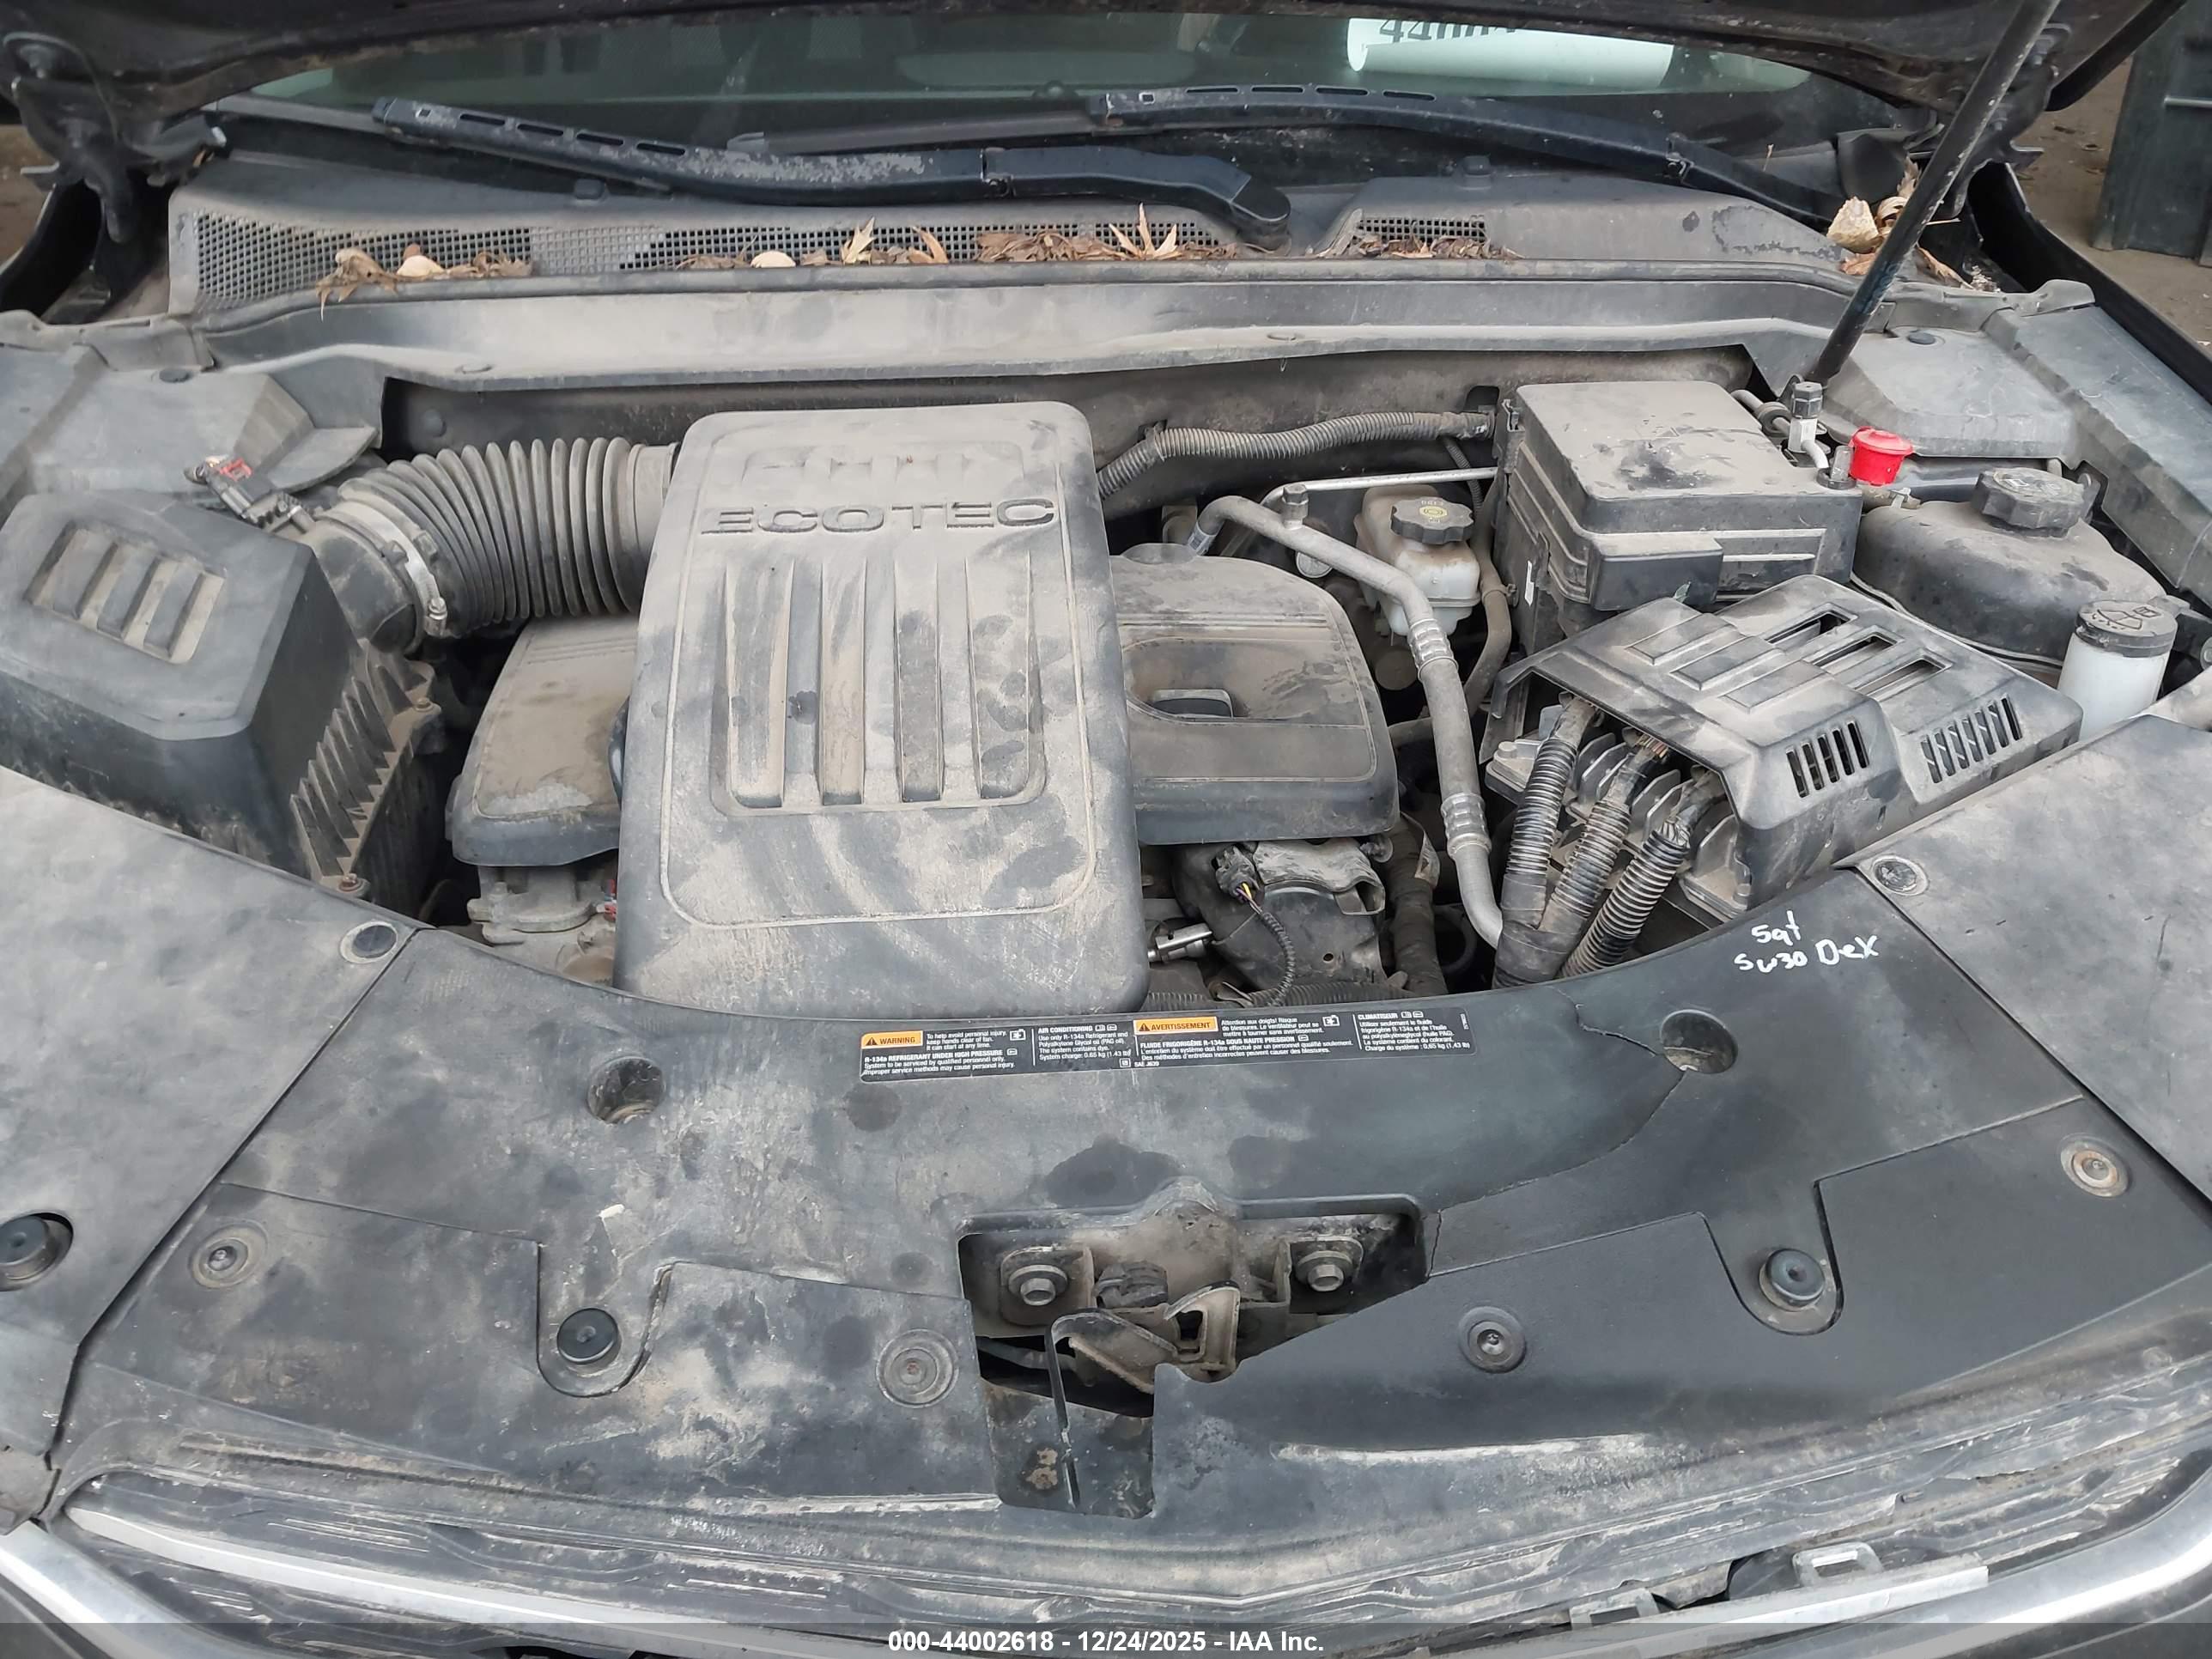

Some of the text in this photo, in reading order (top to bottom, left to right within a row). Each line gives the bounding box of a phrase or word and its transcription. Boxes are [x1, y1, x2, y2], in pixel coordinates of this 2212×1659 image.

[701, 499, 1054, 535] ECOTEC
[1151, 1022, 1210, 1030] AVERTISSEMENT
[879, 1036, 915, 1044] WARNING
